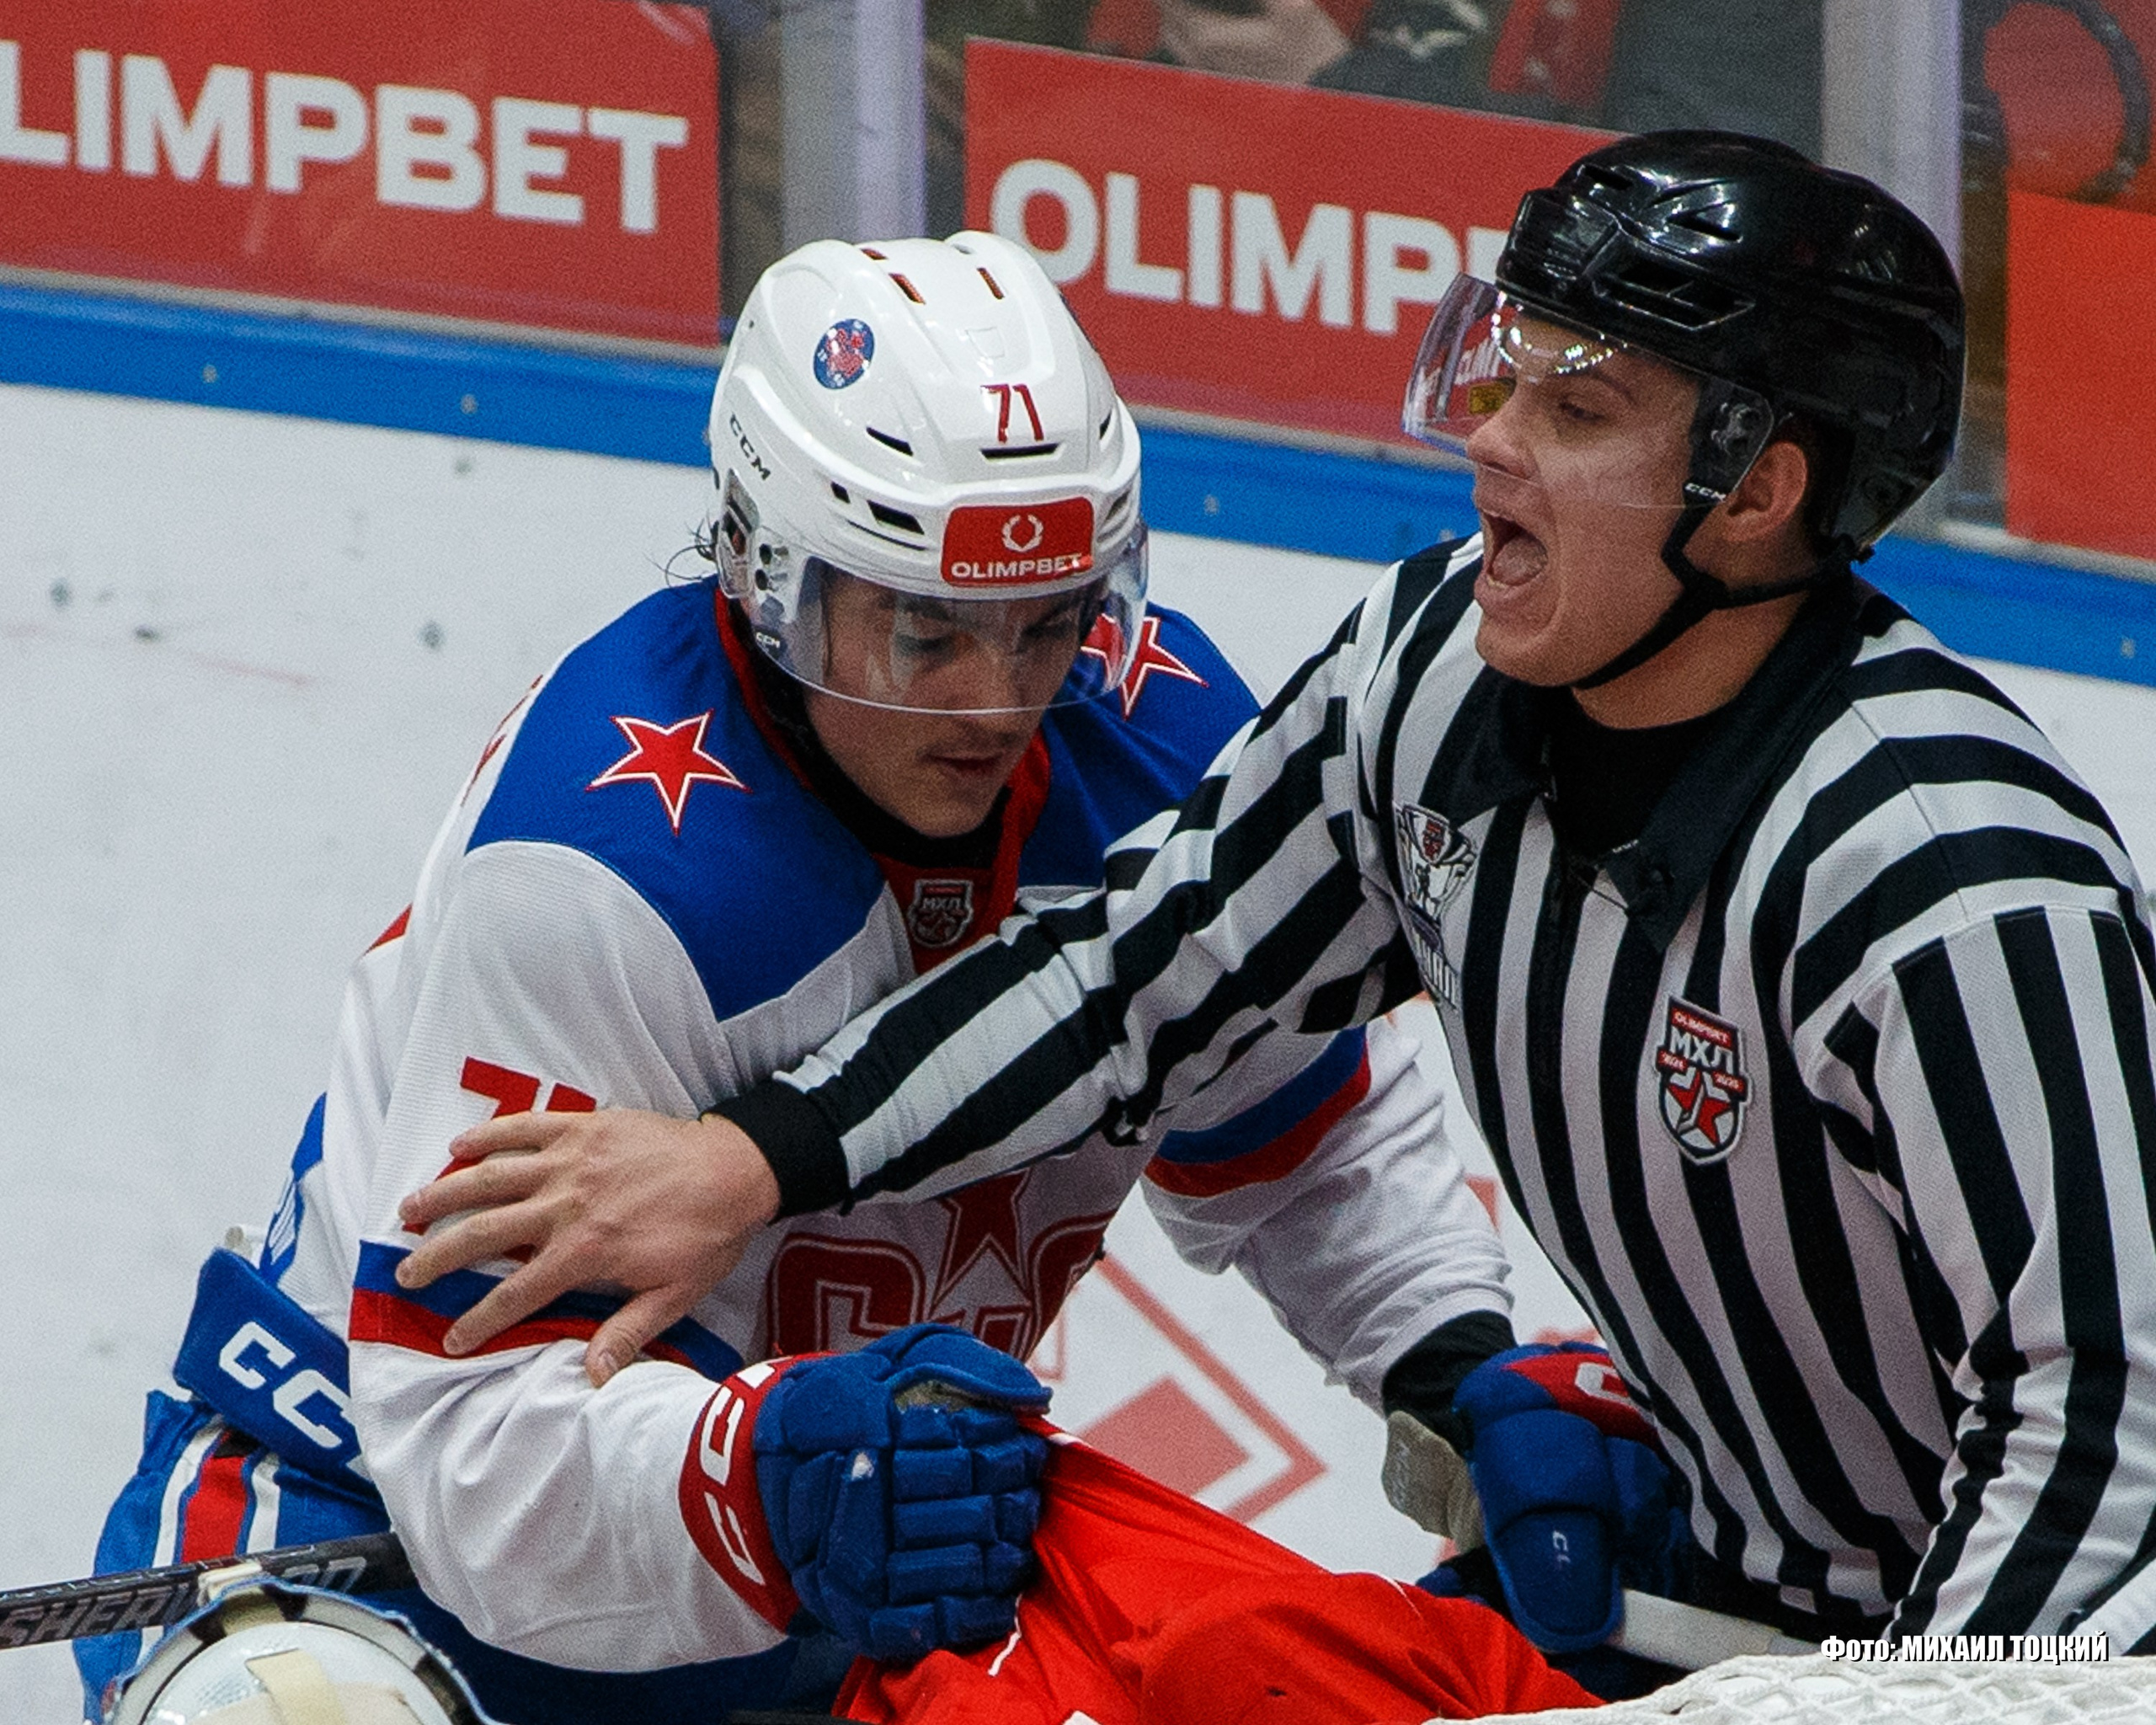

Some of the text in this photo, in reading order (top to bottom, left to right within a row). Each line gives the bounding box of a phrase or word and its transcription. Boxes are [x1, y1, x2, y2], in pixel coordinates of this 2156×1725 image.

[980, 383, 1044, 444] 71
[729, 412, 771, 481] CCM
[1685, 483, 1726, 503] CCM
[951, 553, 1083, 579] OLIMPBET
[1669, 1024, 1734, 1077] МХЛ
[219, 1321, 376, 1482] CC
[699, 1356, 792, 1586] CC
